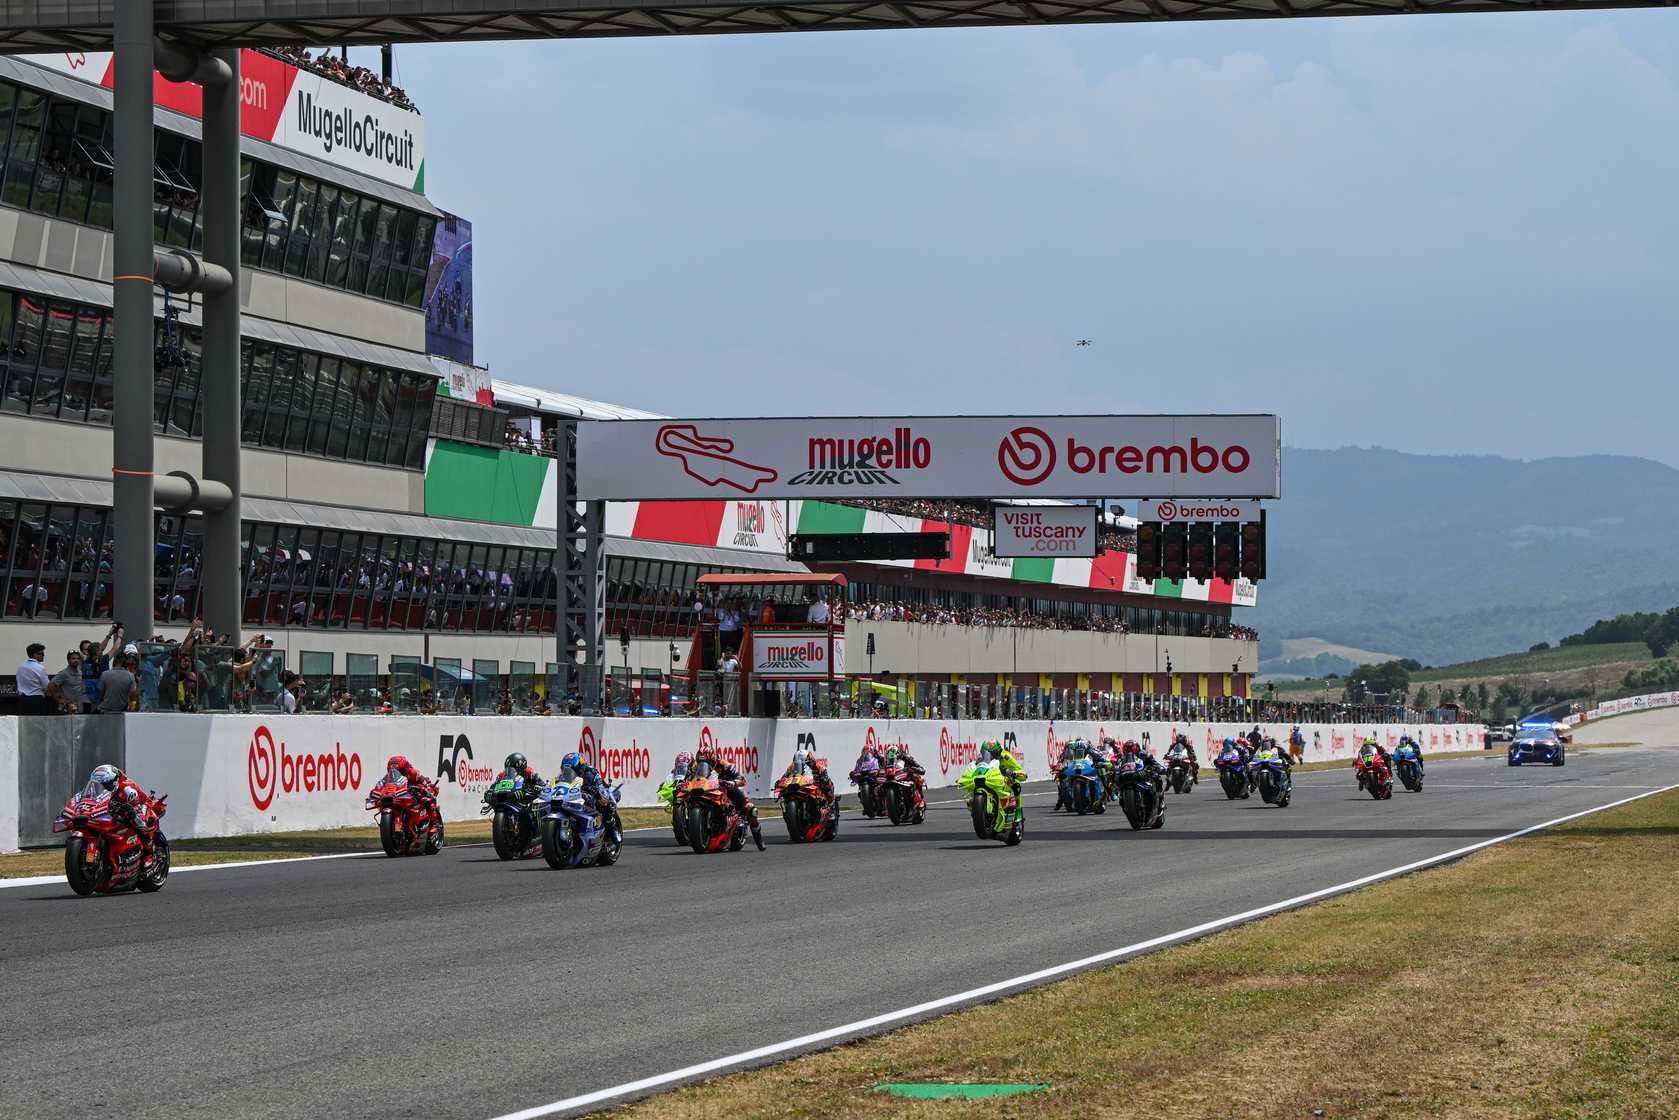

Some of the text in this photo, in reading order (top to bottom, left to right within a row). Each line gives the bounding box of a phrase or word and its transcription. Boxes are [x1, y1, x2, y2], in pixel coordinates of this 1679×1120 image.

[298, 90, 413, 171] MugelloCircuit
[808, 427, 931, 470] mugello
[1067, 437, 1250, 474] brembo
[787, 470, 901, 485] CIRCUIT
[1003, 512, 1042, 525] VISIT
[1180, 505, 1240, 517] brembo
[1013, 526, 1087, 538] tuscany
[1030, 539, 1076, 551] .com
[767, 642, 824, 661] mugello
[757, 661, 810, 669] CIRCUIT
[281, 742, 362, 793] brembo
[599, 739, 650, 779] brembo
[468, 765, 493, 782] brembo
